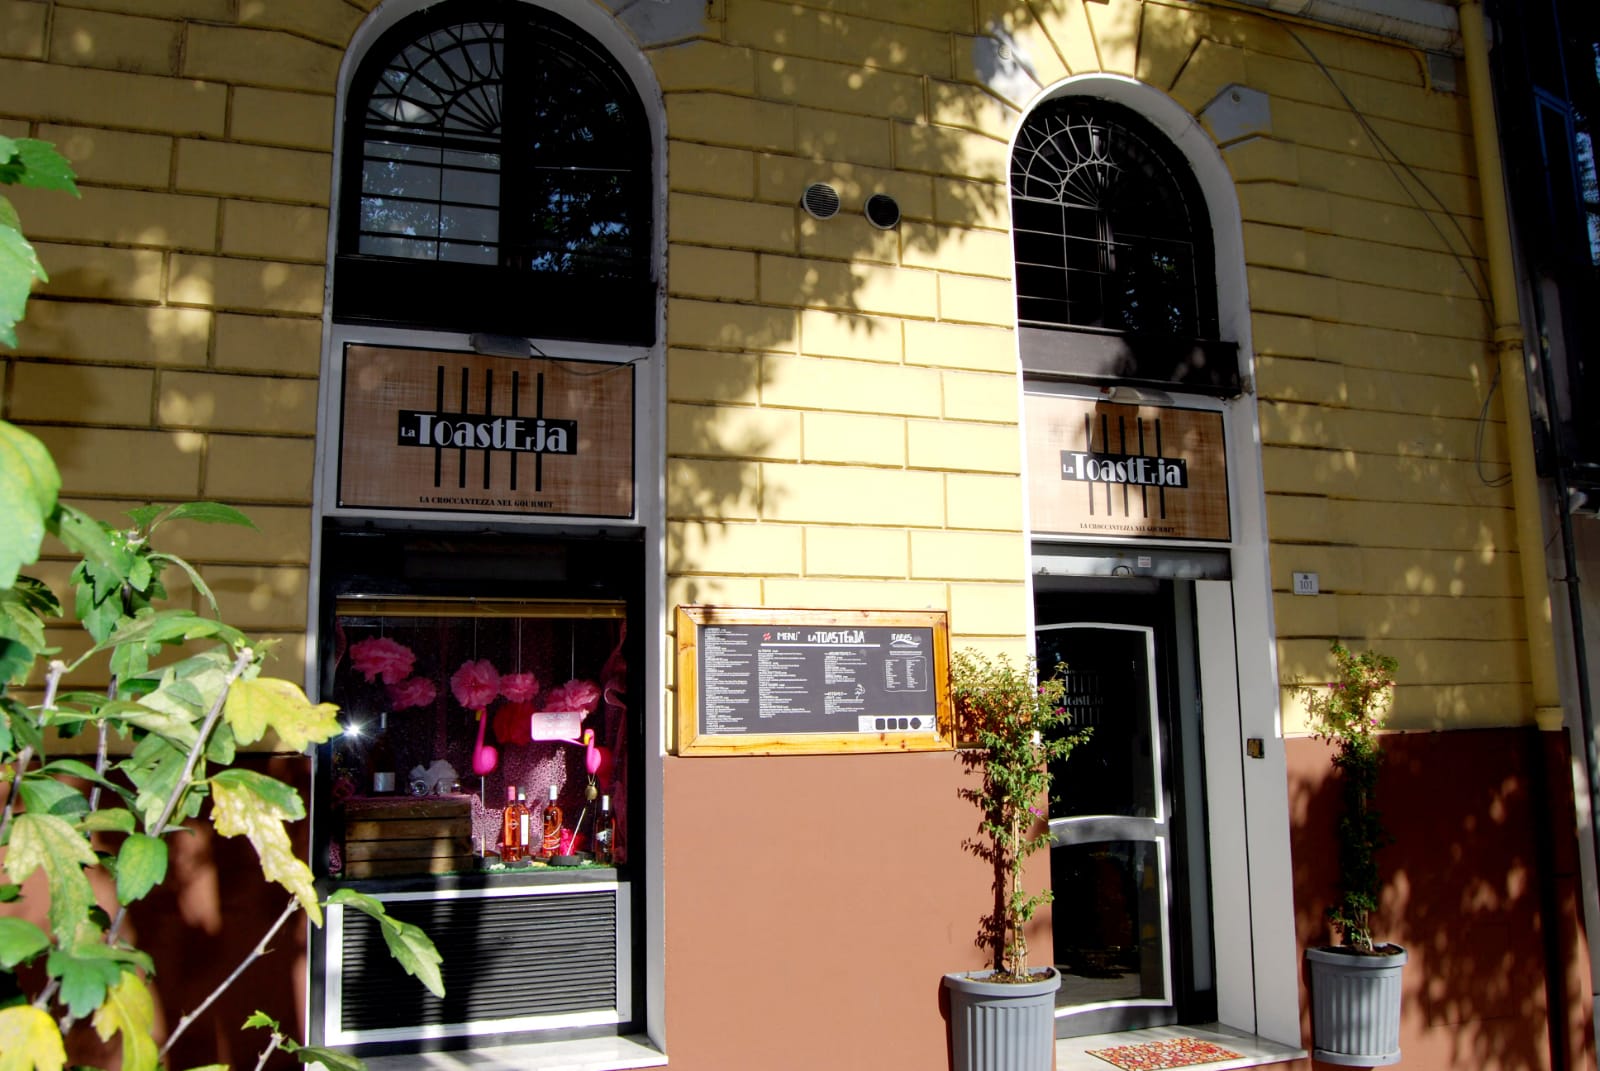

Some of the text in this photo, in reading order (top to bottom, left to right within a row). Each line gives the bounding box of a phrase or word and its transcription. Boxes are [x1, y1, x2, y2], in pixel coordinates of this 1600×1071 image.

[401, 413, 568, 452] La ToastErja
[1071, 453, 1182, 486] ToastErja
[419, 496, 553, 509] LA CROCCANTEZZA NEL GOURMET
[1299, 580, 1313, 590] 101
